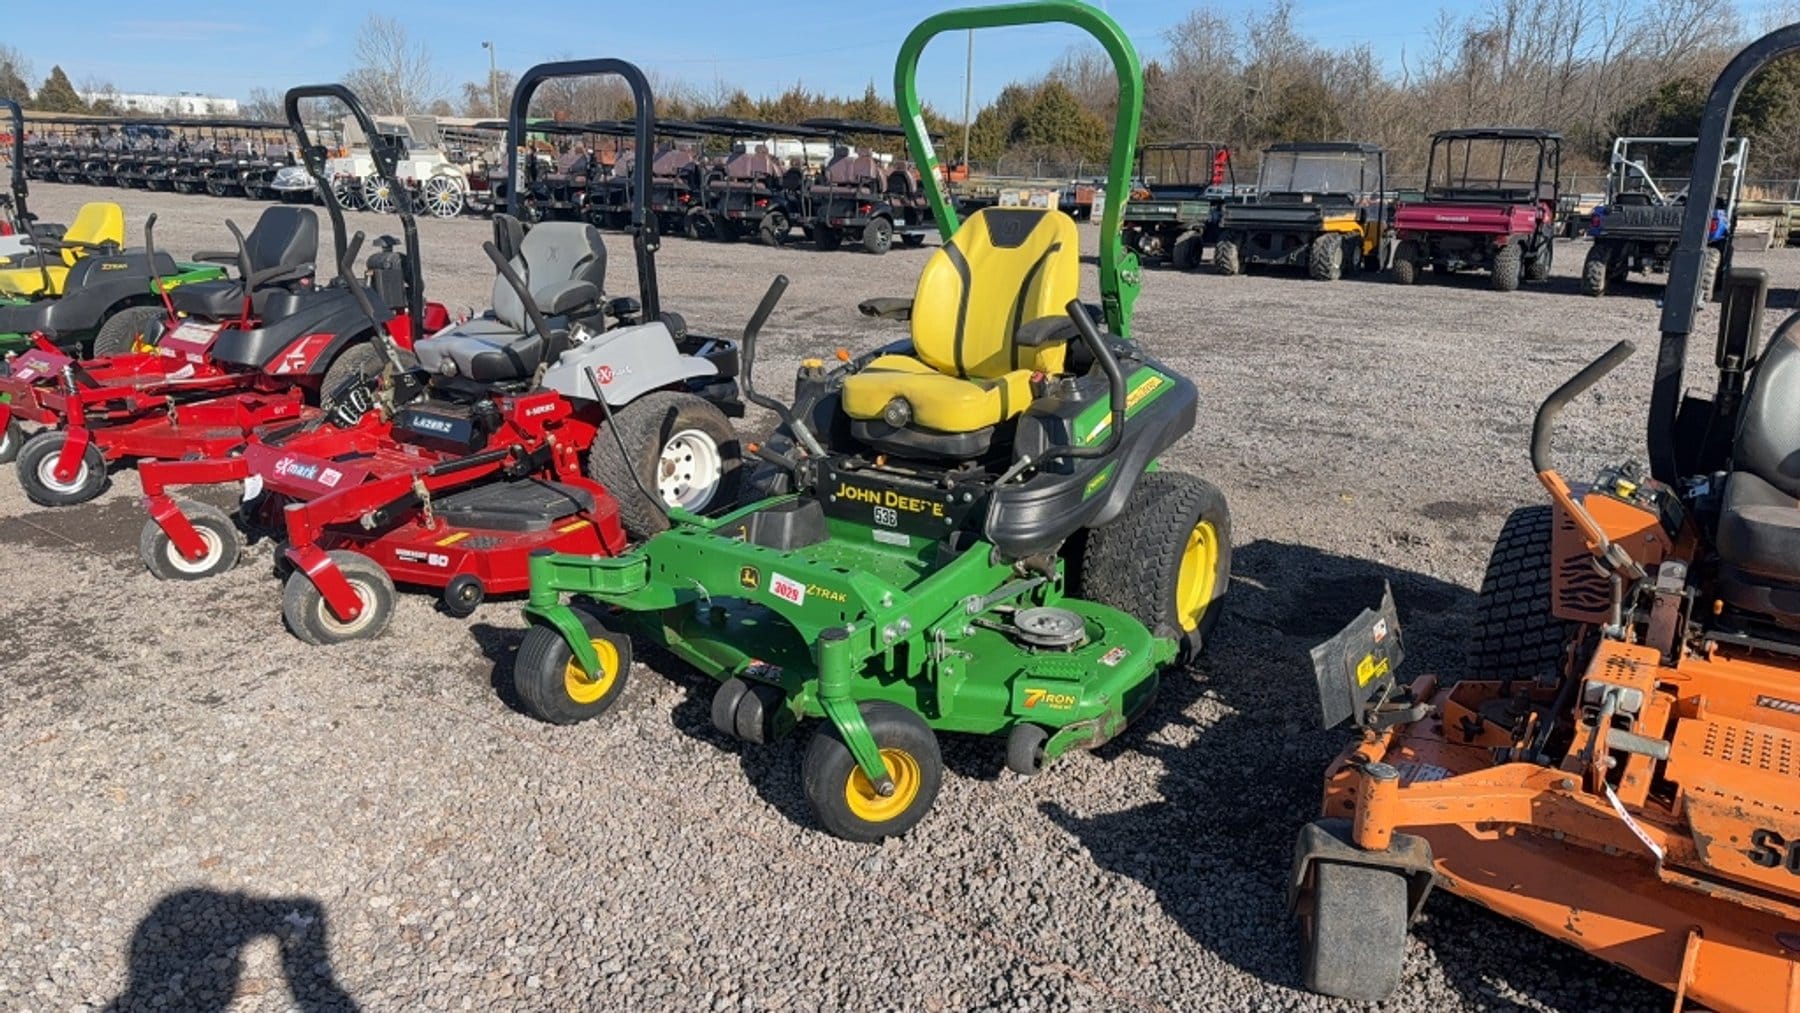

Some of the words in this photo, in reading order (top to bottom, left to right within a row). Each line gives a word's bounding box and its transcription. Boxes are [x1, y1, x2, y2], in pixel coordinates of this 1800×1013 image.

[1623, 205, 1682, 225] YAMAHA
[836, 482, 881, 504] JOHN
[874, 505, 898, 527] 536
[806, 583, 847, 602] ZTRAK
[1023, 688, 1047, 709] 7
[1041, 694, 1076, 705] IRON
[1747, 827, 1800, 878] S
